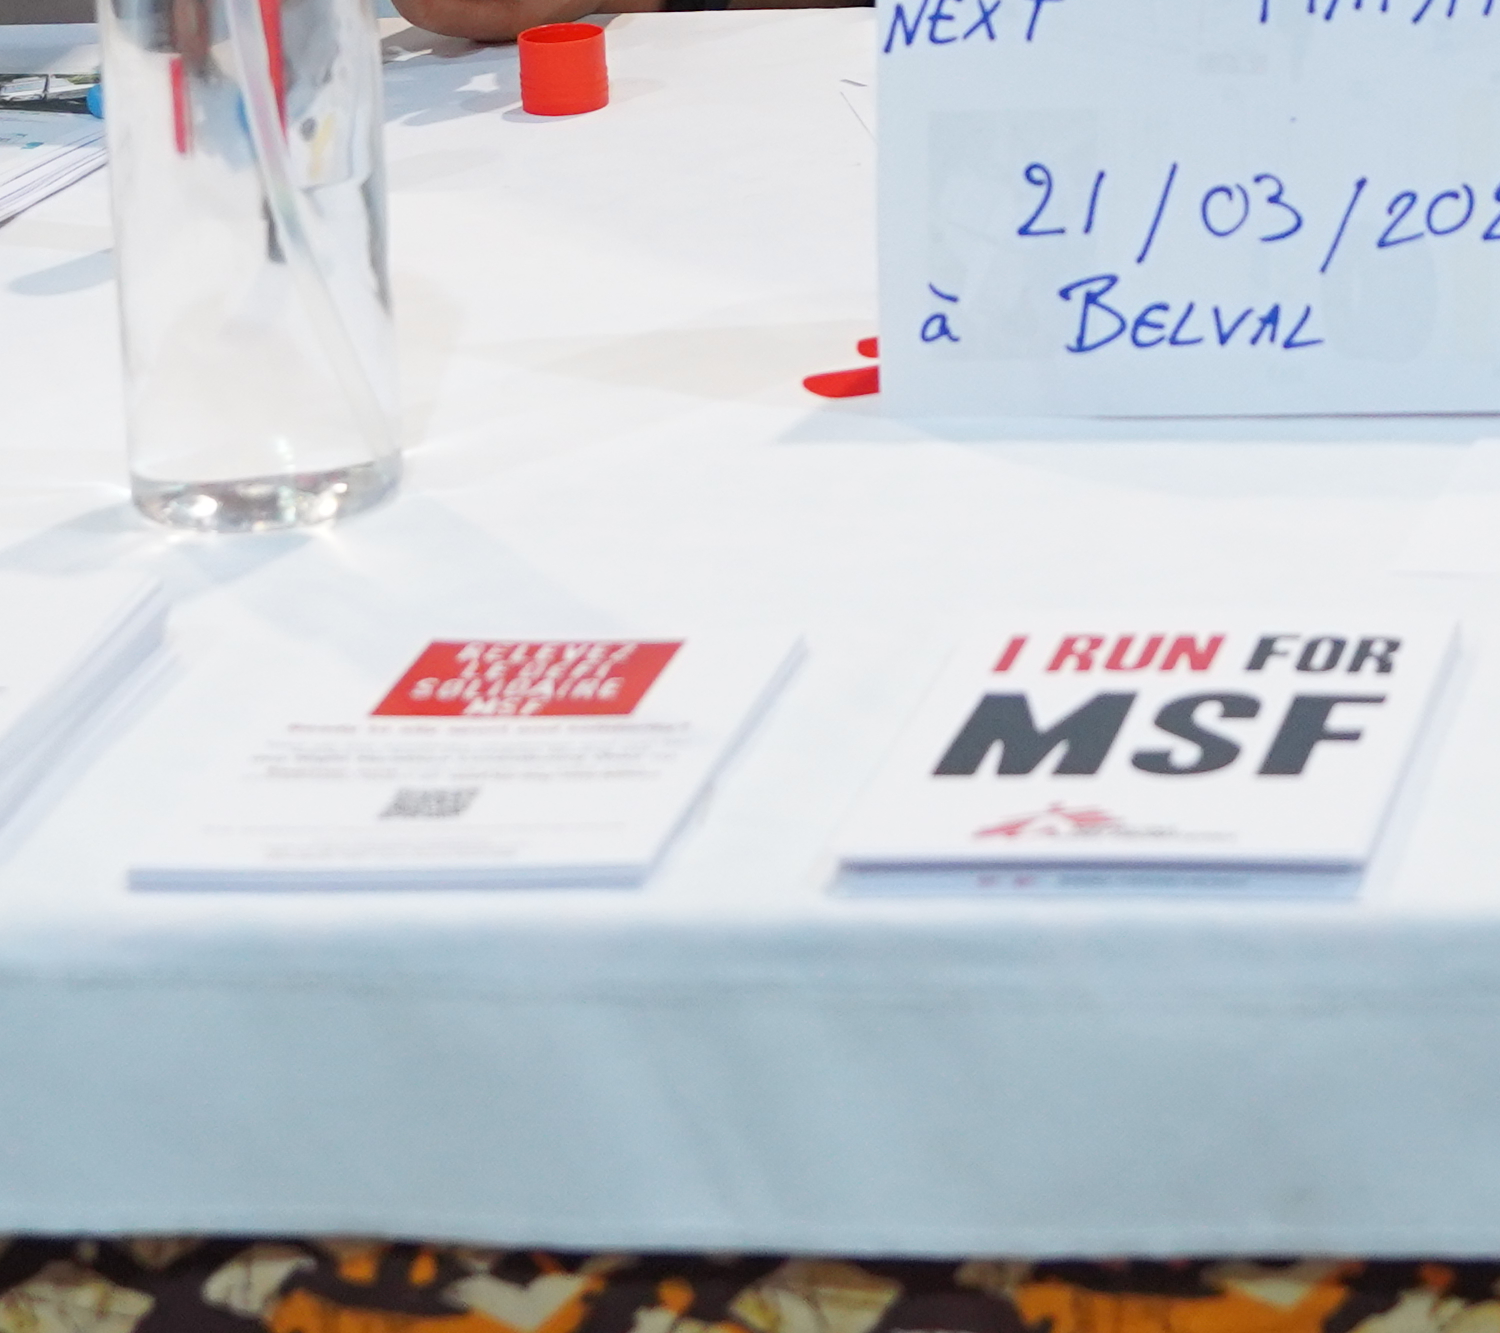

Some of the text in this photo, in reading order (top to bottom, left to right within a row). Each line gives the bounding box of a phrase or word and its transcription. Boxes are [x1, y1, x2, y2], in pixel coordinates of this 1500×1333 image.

[918, 282, 961, 345] à
[990, 633, 1403, 675] I RUN FOR
[409, 676, 627, 702] SOLIDAIRE
[931, 690, 1389, 777] MSF
